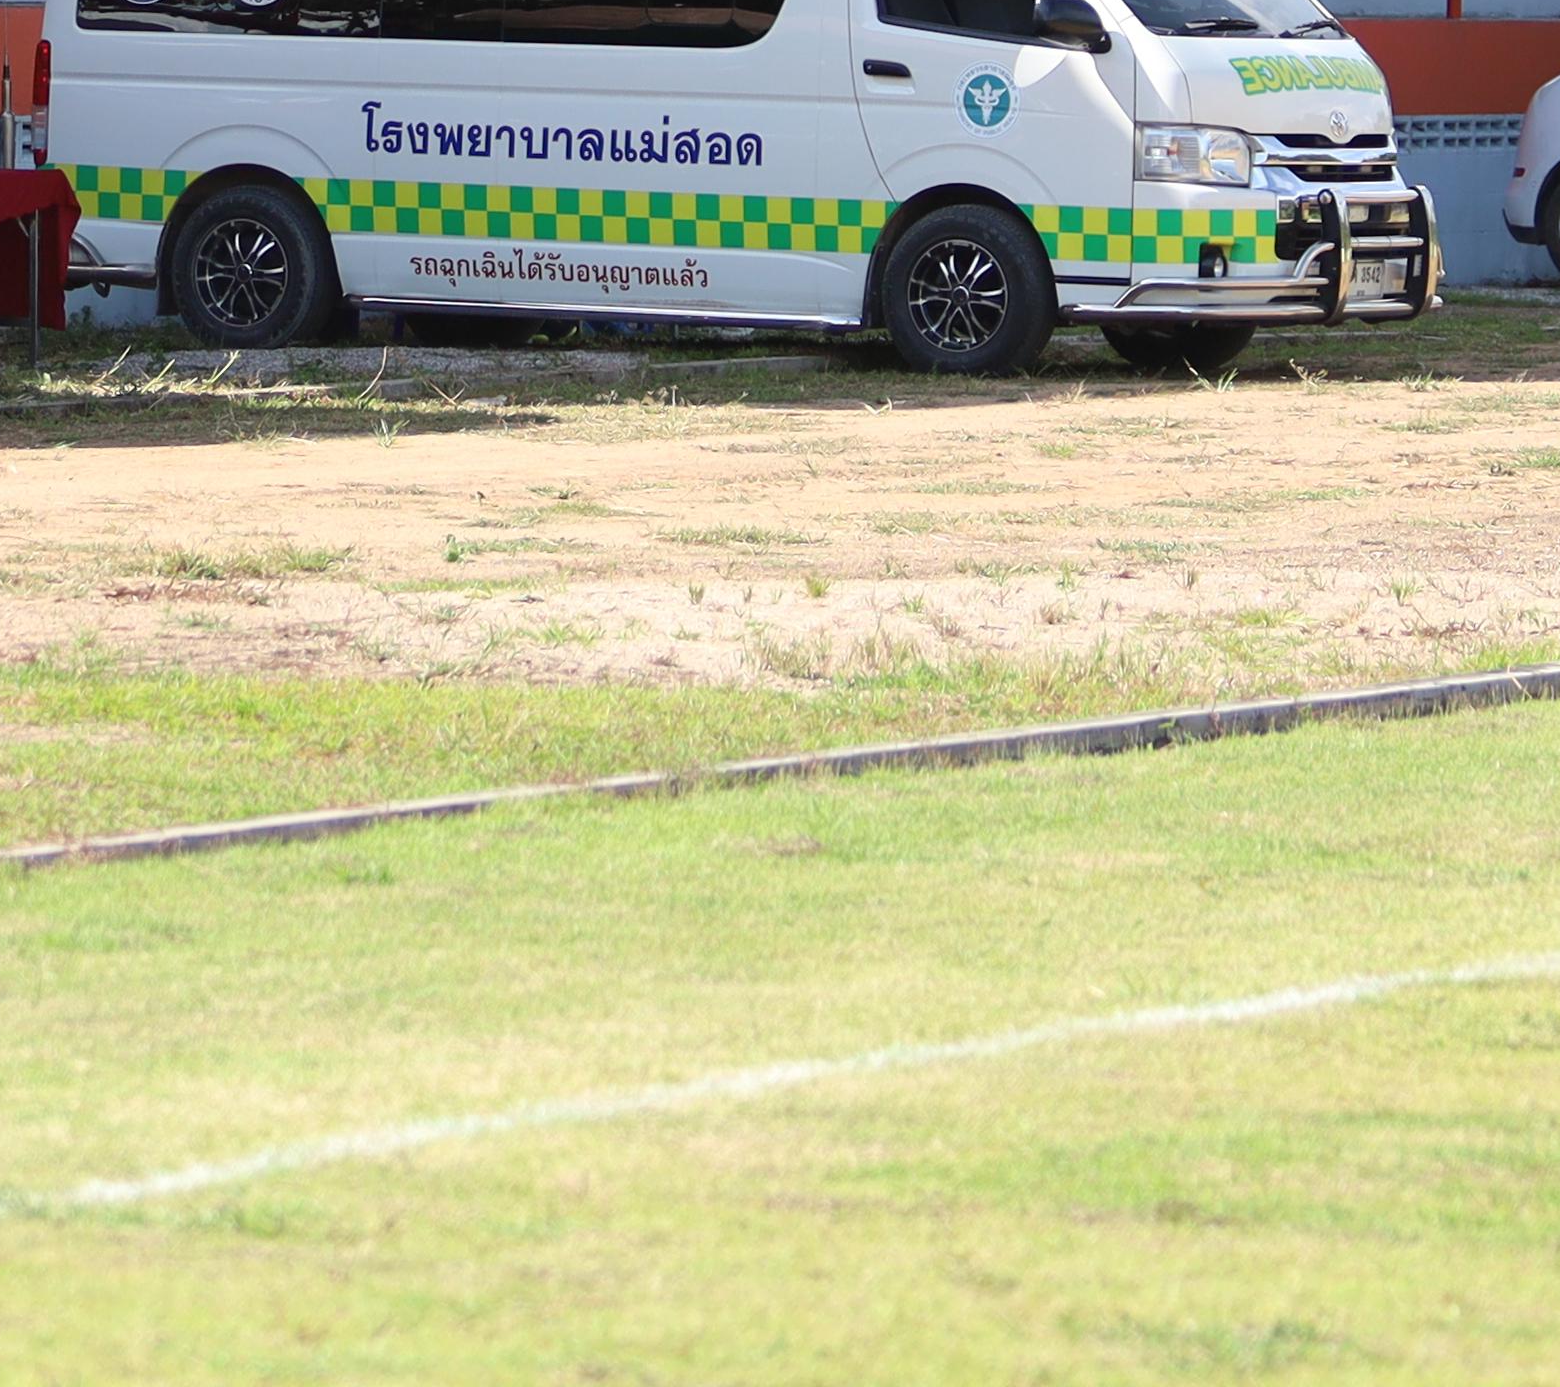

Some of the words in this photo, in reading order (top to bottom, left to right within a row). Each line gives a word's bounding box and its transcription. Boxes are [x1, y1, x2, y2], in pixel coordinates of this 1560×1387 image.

[361, 101, 763, 167] โรงพยาบาลแม่สอด
[409, 248, 709, 294] รถฉุกเฉินได้รับอนุญาตแล้ว
